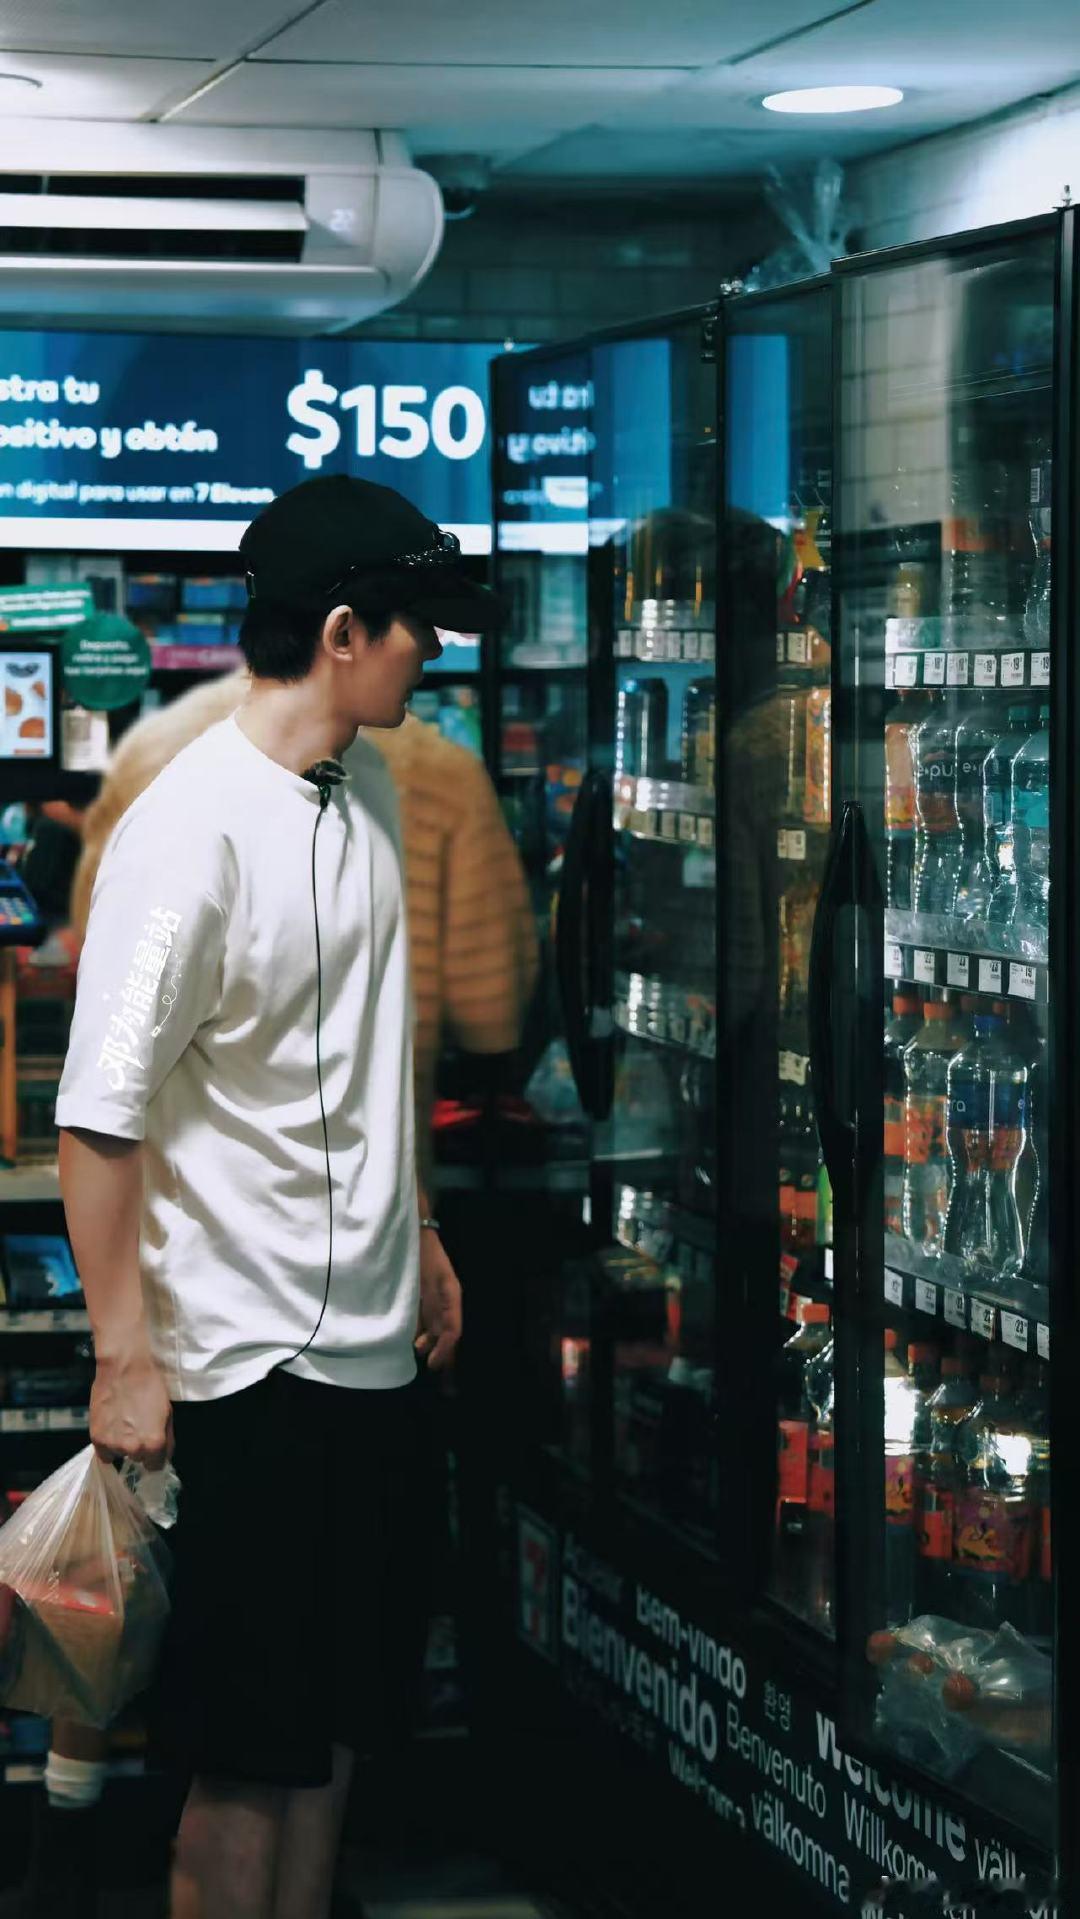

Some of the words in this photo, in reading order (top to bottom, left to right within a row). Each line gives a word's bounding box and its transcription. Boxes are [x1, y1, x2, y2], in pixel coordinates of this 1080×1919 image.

[64, 375, 99, 404] tu
[286, 368, 486, 469] $150
[16, 480, 78, 505] digital
[79, 485, 124, 505] para
[126, 486, 166, 502] usar
[168, 486, 194, 502] en
[195, 482, 209, 503] 7
[100, 427, 122, 458] y
[562, 1575, 718, 1763] Bienvenido
[726, 1702, 827, 1819] Benvenuto
[751, 1792, 851, 1902] välkomna
